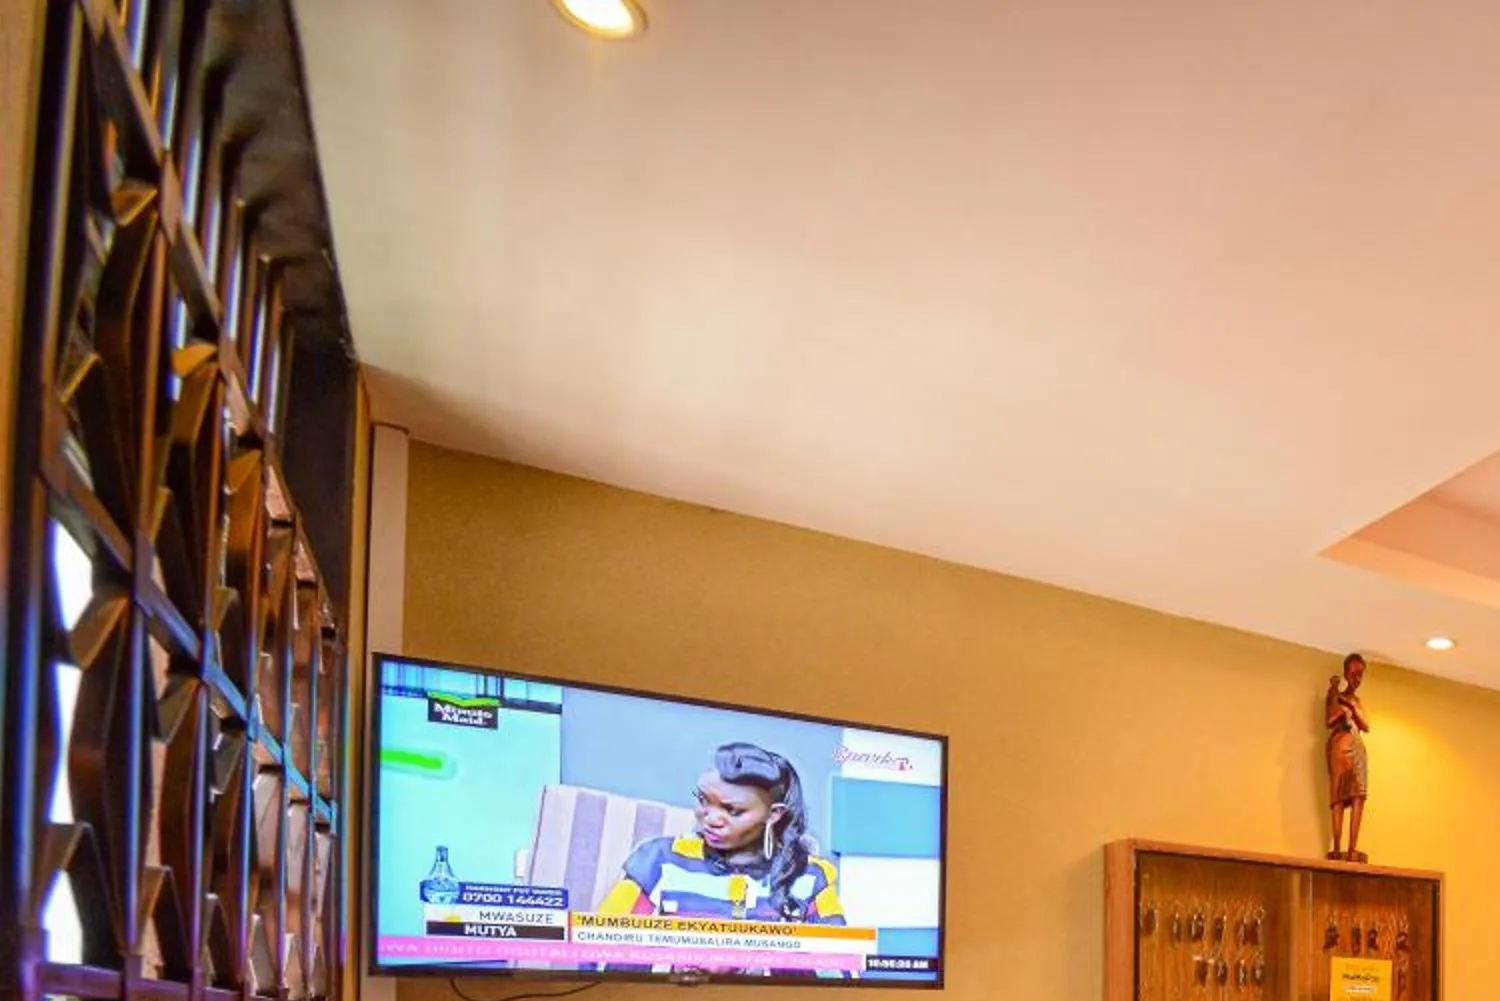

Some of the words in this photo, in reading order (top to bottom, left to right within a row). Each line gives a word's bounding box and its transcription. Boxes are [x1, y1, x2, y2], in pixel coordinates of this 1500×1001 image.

[462, 892, 502, 904] 0700
[479, 910, 554, 924] MWASUZE
[464, 924, 517, 937] MUTYA
